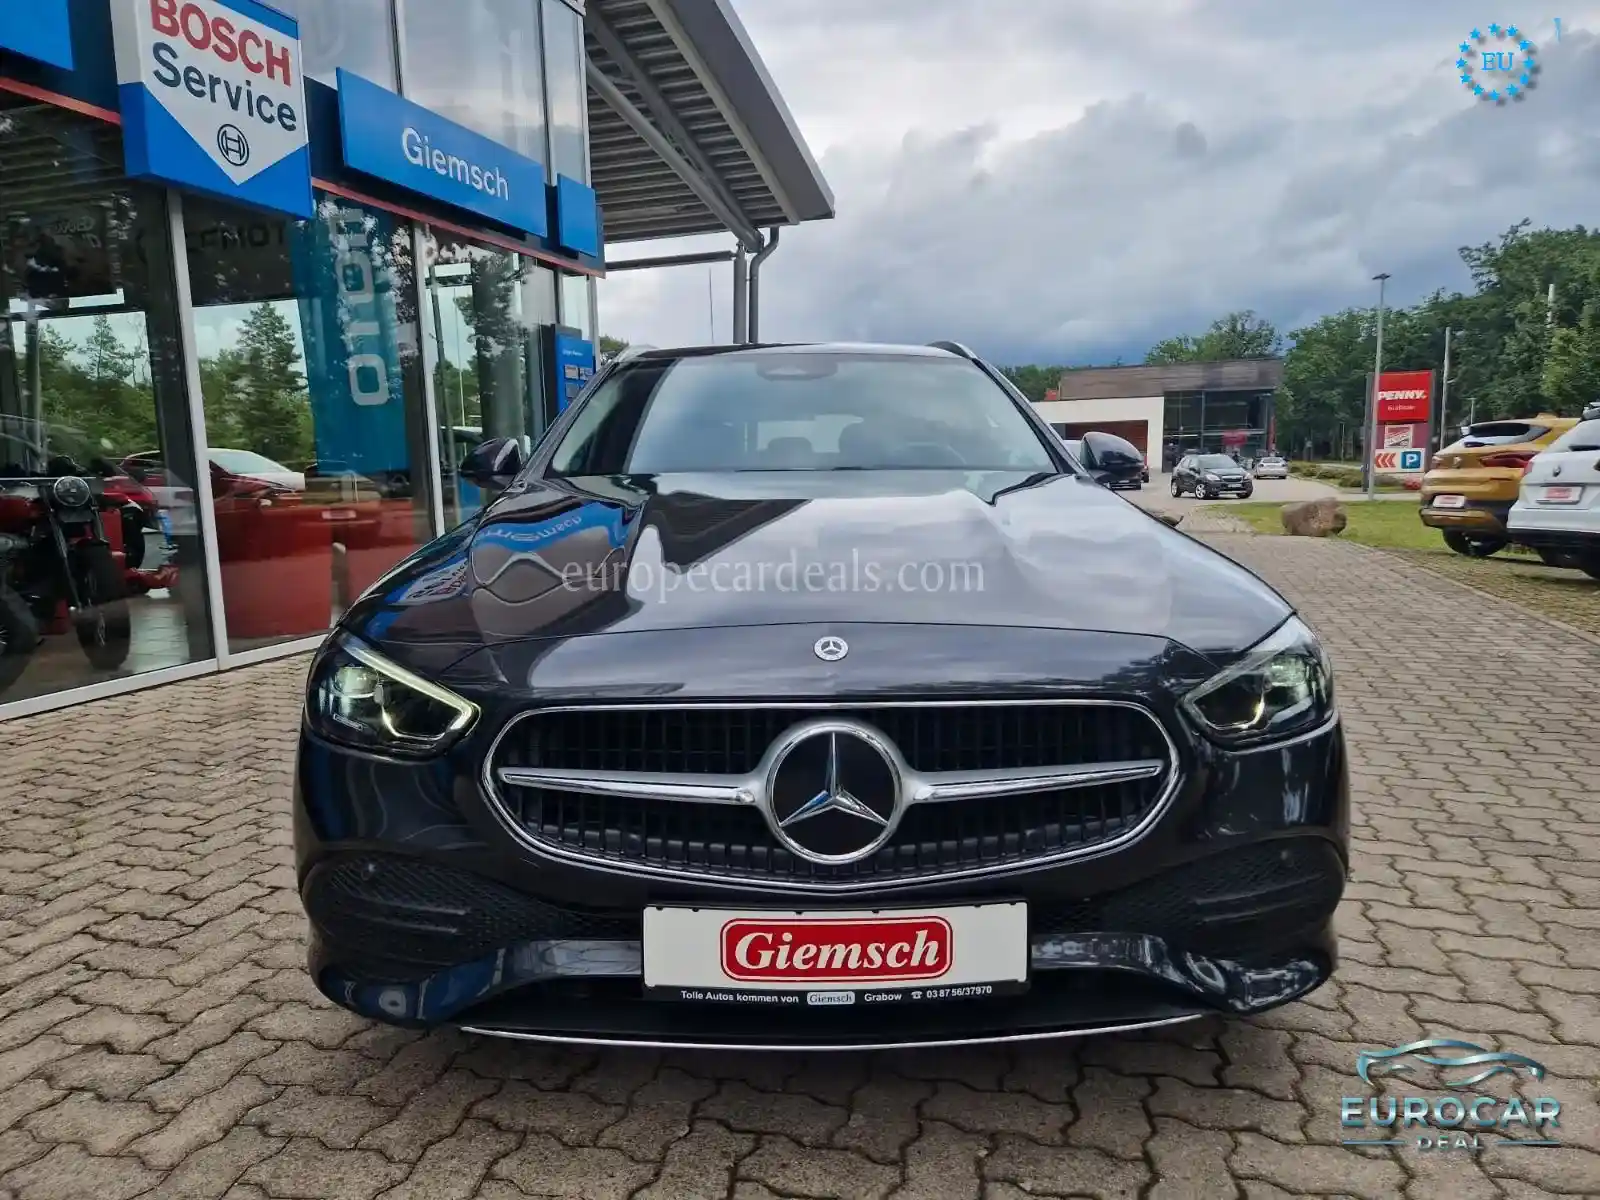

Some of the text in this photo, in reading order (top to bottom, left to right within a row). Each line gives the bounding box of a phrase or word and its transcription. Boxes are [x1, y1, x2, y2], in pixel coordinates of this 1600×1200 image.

[150, 0, 292, 87] BOSCH
[152, 42, 297, 132] Service
[402, 127, 509, 201] Giemsch
[1406, 453, 1419, 467] P
[735, 929, 941, 970] Giemsch
[681, 990, 703, 1000] Tolle
[705, 991, 734, 1001] Autos
[736, 993, 779, 1003] kommen
[781, 995, 799, 1003] von
[864, 992, 902, 1002] Grabow
